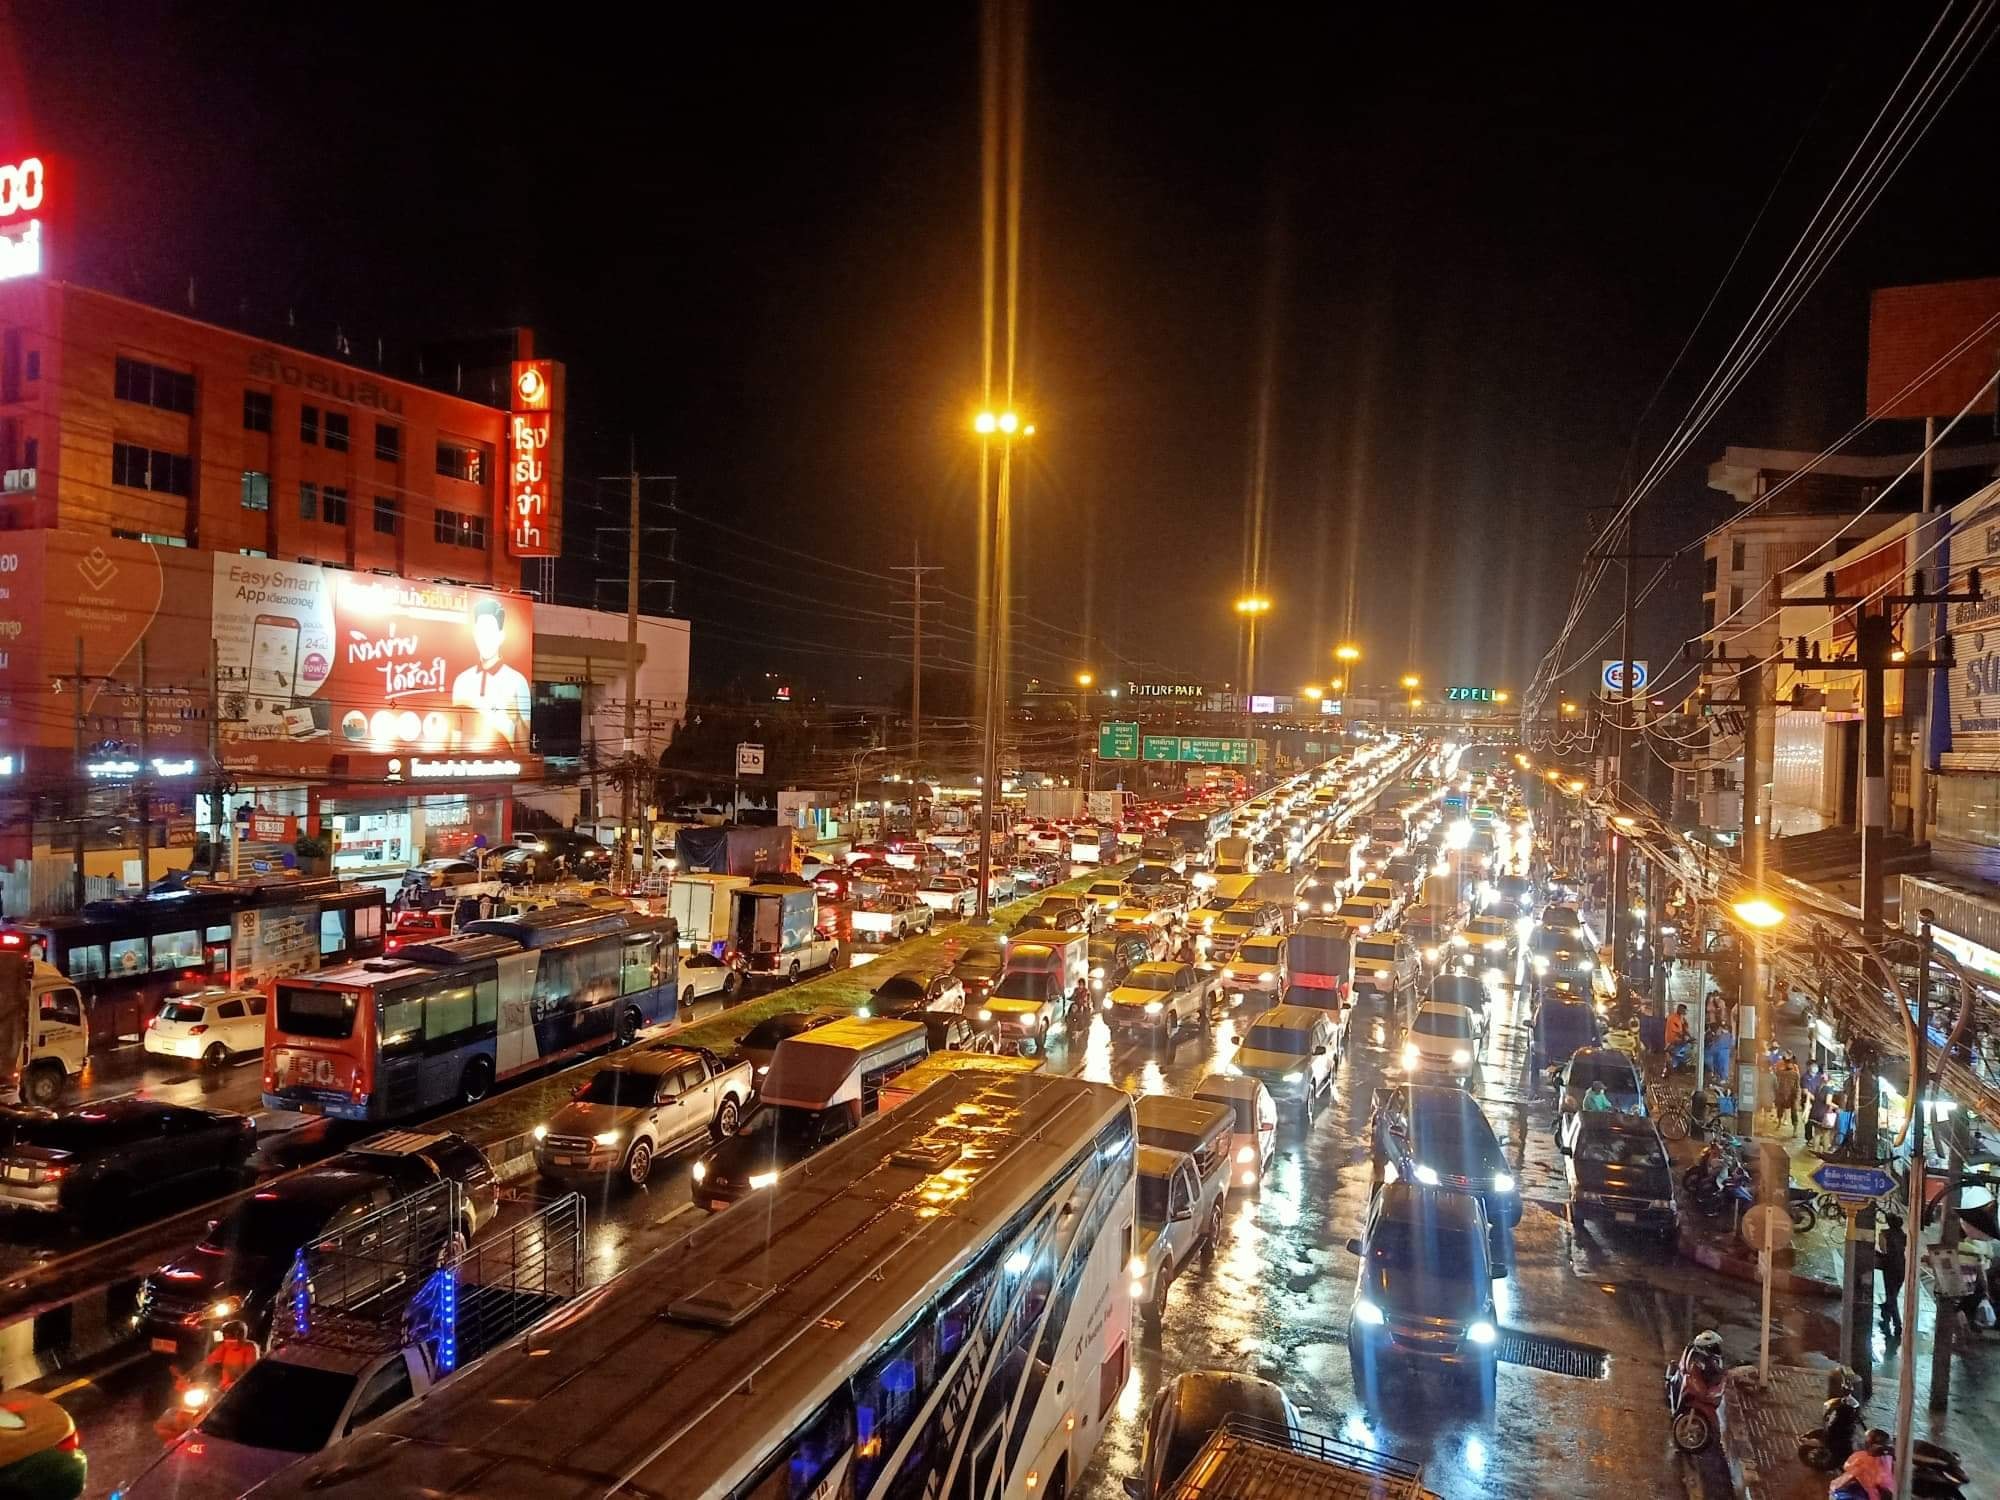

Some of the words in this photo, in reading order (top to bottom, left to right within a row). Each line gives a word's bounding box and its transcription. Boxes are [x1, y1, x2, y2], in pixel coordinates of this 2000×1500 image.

[230, 565, 270, 589] Easy
[271, 571, 321, 593] Smart
[235, 585, 266, 605] App
[1874, 1178, 1885, 1189] 13
